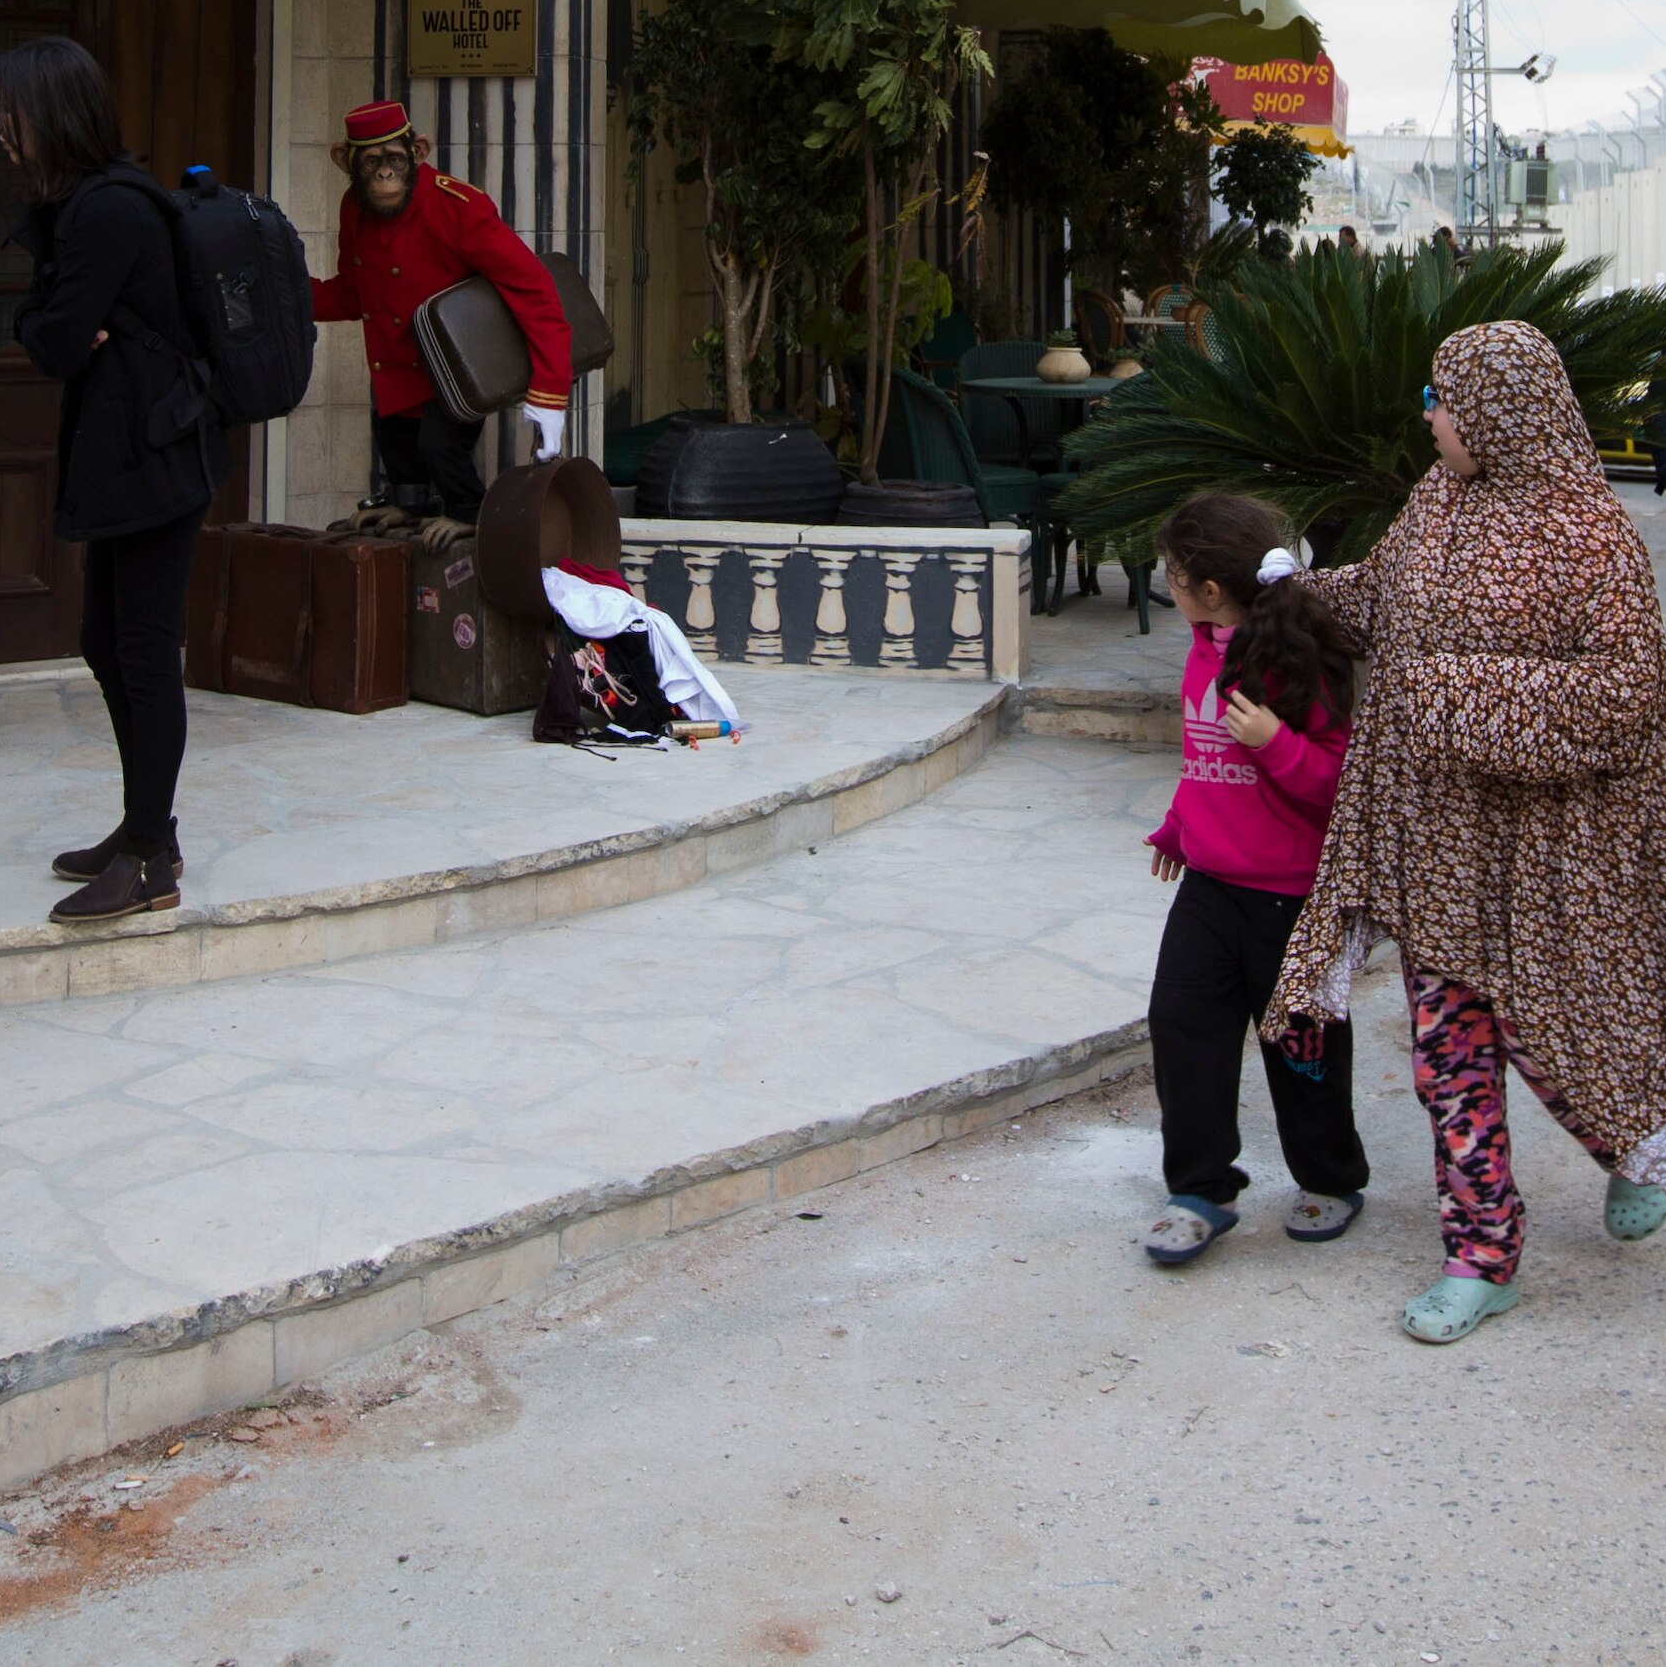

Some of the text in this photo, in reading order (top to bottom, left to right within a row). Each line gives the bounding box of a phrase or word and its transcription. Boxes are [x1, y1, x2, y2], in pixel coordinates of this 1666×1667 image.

[422, 9, 522, 32] WALLED OFF
[453, 33, 489, 49] HOTEL
[1233, 62, 1330, 86] BANKSY'S
[1251, 90, 1305, 114] SHOP
[1182, 754, 1259, 786] adidas
